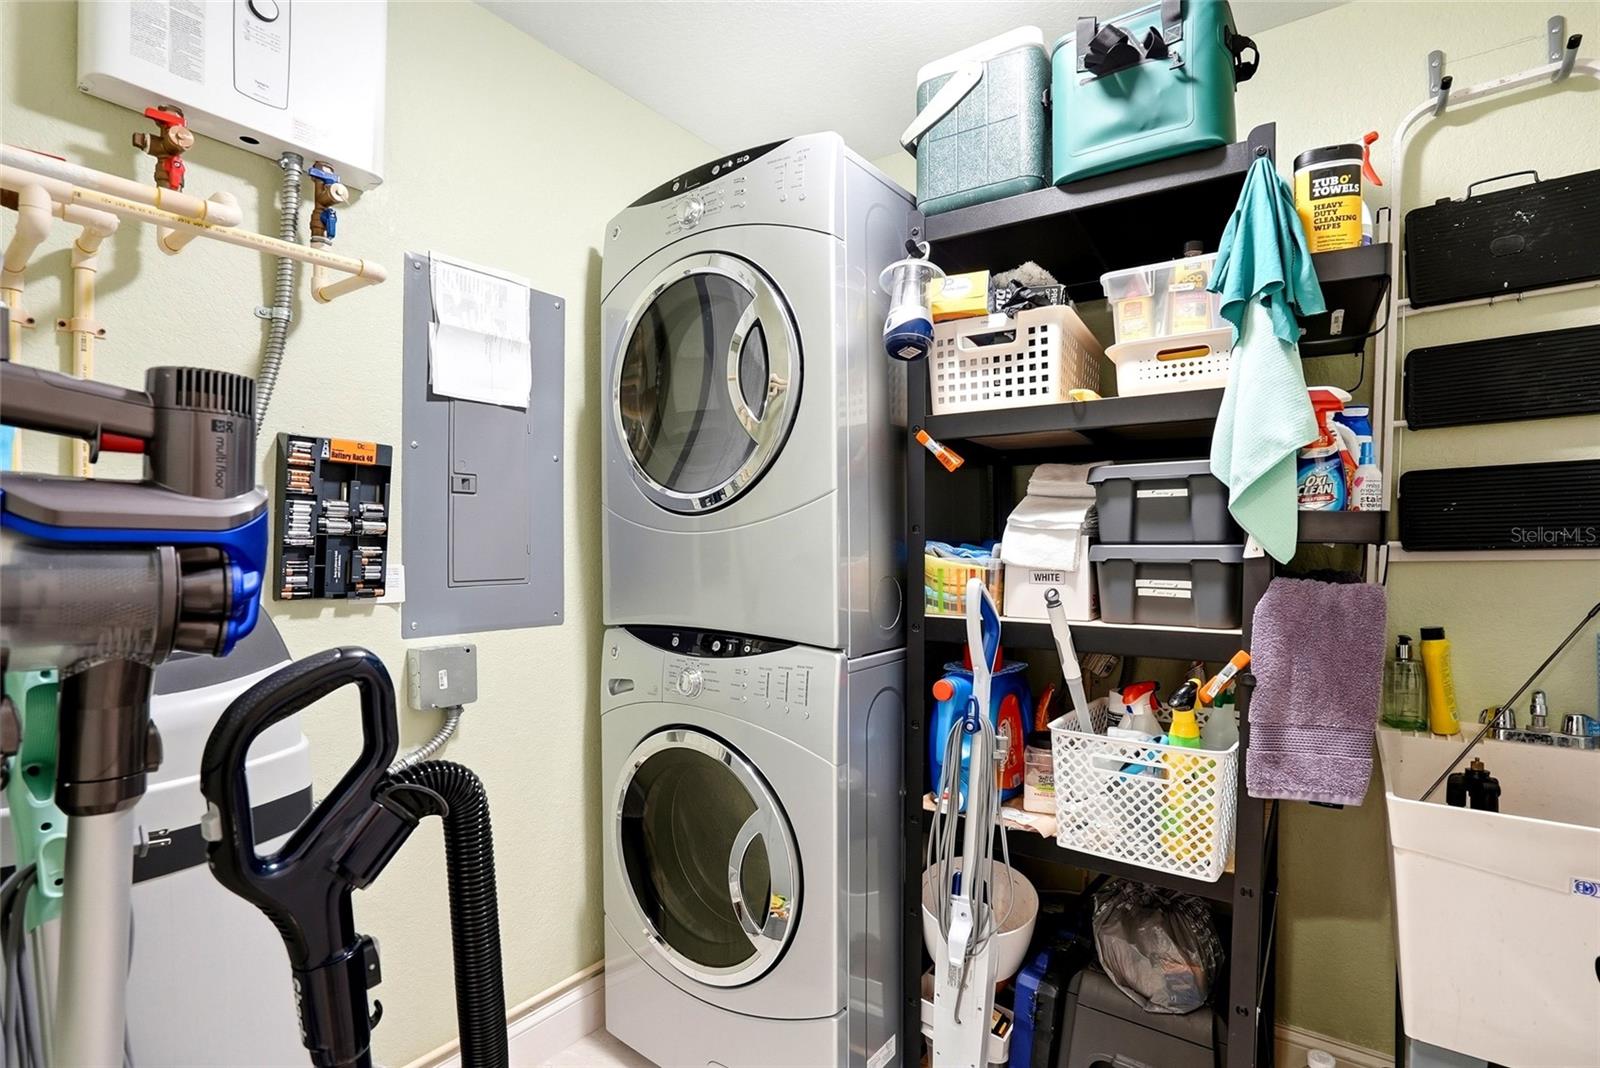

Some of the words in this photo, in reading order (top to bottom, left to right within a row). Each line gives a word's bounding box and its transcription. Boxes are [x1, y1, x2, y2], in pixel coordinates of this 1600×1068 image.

[1312, 176, 1339, 188] TUB
[1312, 184, 1359, 197] TOWELS
[1314, 202, 1343, 211] HEAVY
[1313, 209, 1339, 218] DUTY
[1314, 215, 1357, 225] CLEANING
[1314, 222, 1341, 231] WIPES
[215, 436, 227, 464] multi
[331, 451, 352, 461] Battery
[352, 453, 366, 462] Rack
[215, 464, 227, 489] floor
[1305, 475, 1329, 487] OXI
[1298, 483, 1333, 496] CLEAN
[1034, 573, 1061, 582] WHITE
